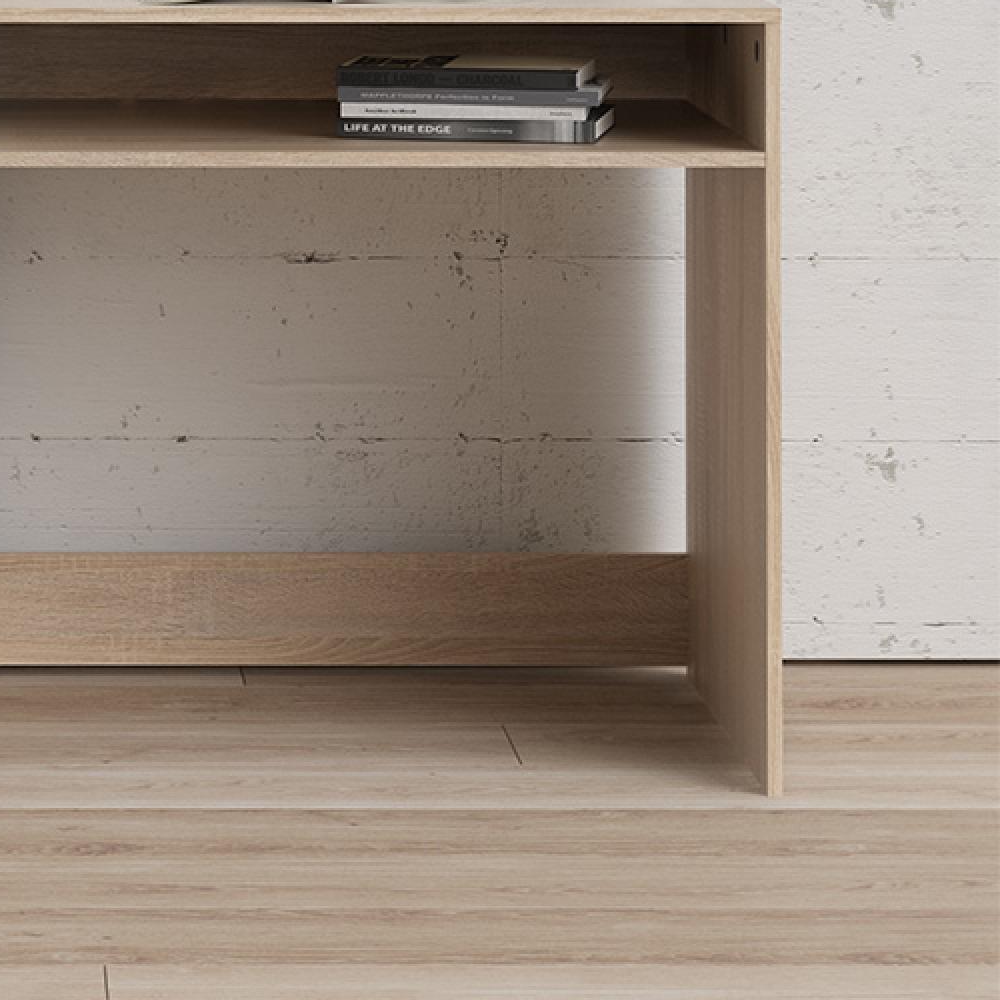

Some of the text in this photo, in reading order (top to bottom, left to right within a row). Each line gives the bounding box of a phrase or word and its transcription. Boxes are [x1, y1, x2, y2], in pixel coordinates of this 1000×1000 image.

[343, 123, 452, 135] LIFE AT THE EDGE
